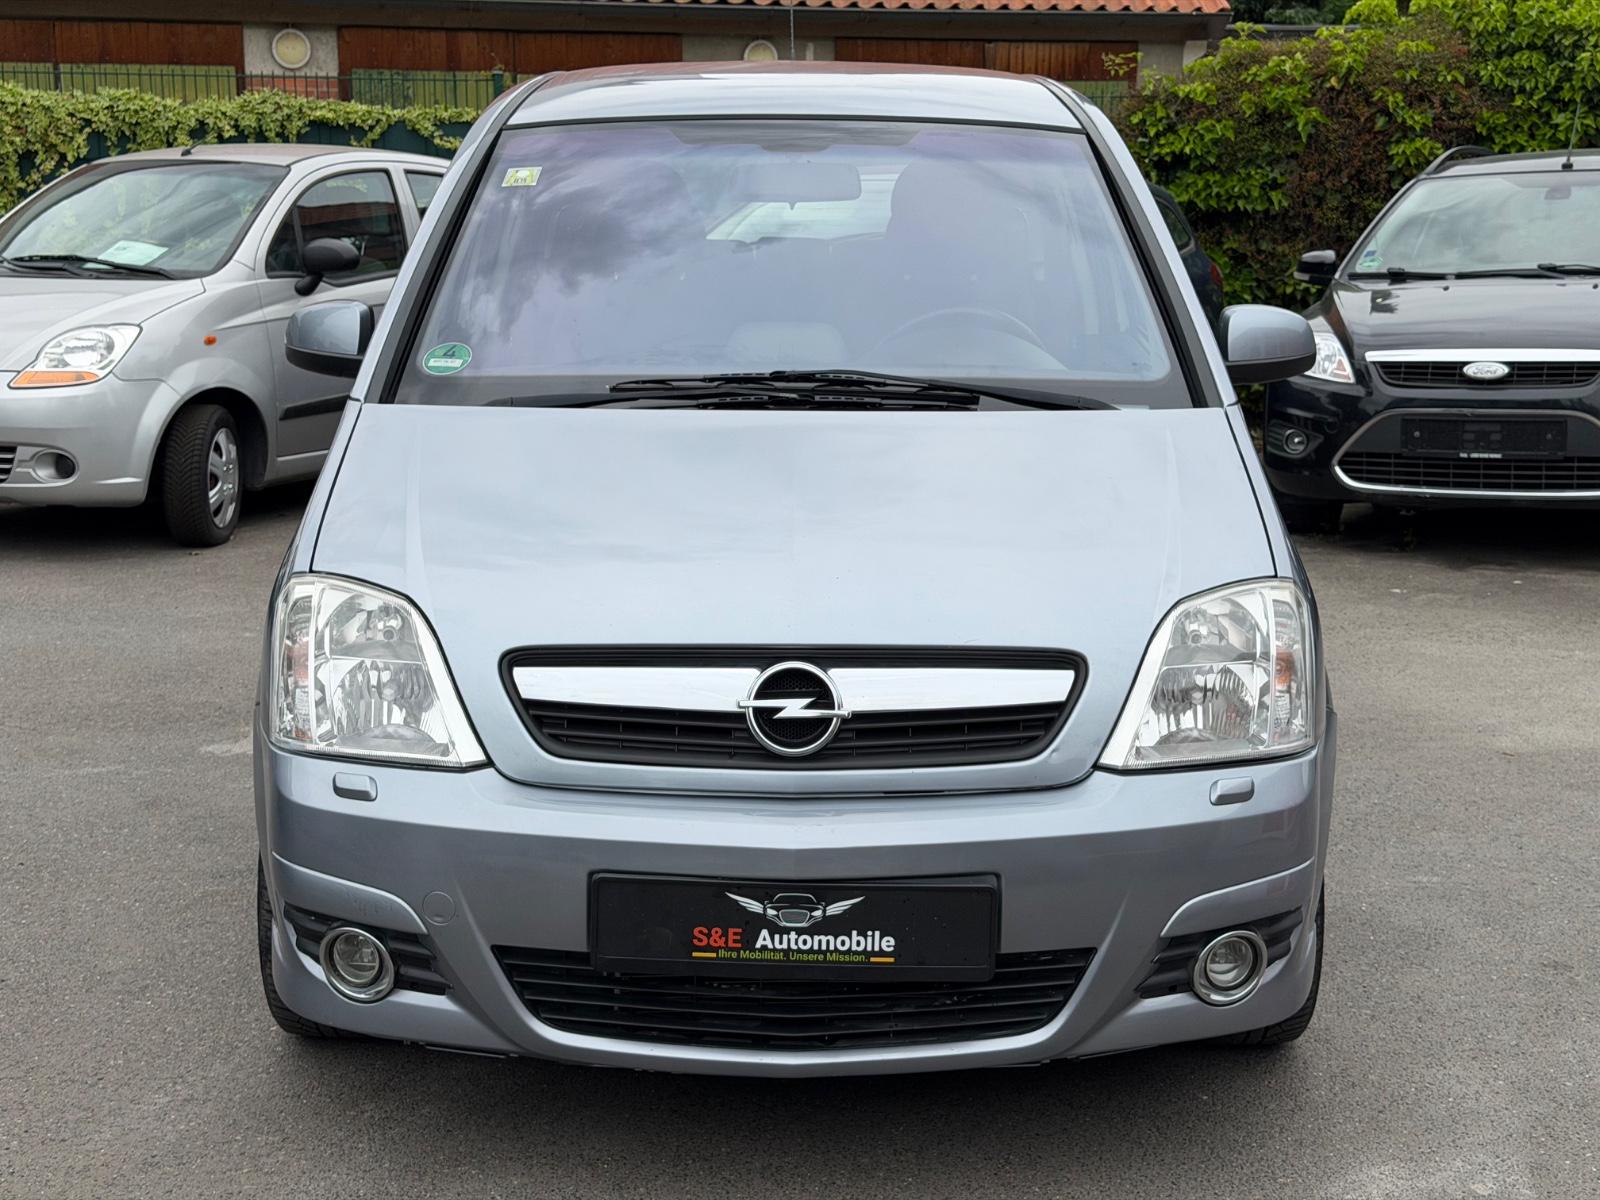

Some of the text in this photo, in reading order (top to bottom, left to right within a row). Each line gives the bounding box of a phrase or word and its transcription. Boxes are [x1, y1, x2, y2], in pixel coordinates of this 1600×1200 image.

[442, 344, 457, 358] 4
[692, 926, 896, 951] S&E Automobile
[718, 949, 868, 962] Ihre Mobilität. Unsere Mission.
